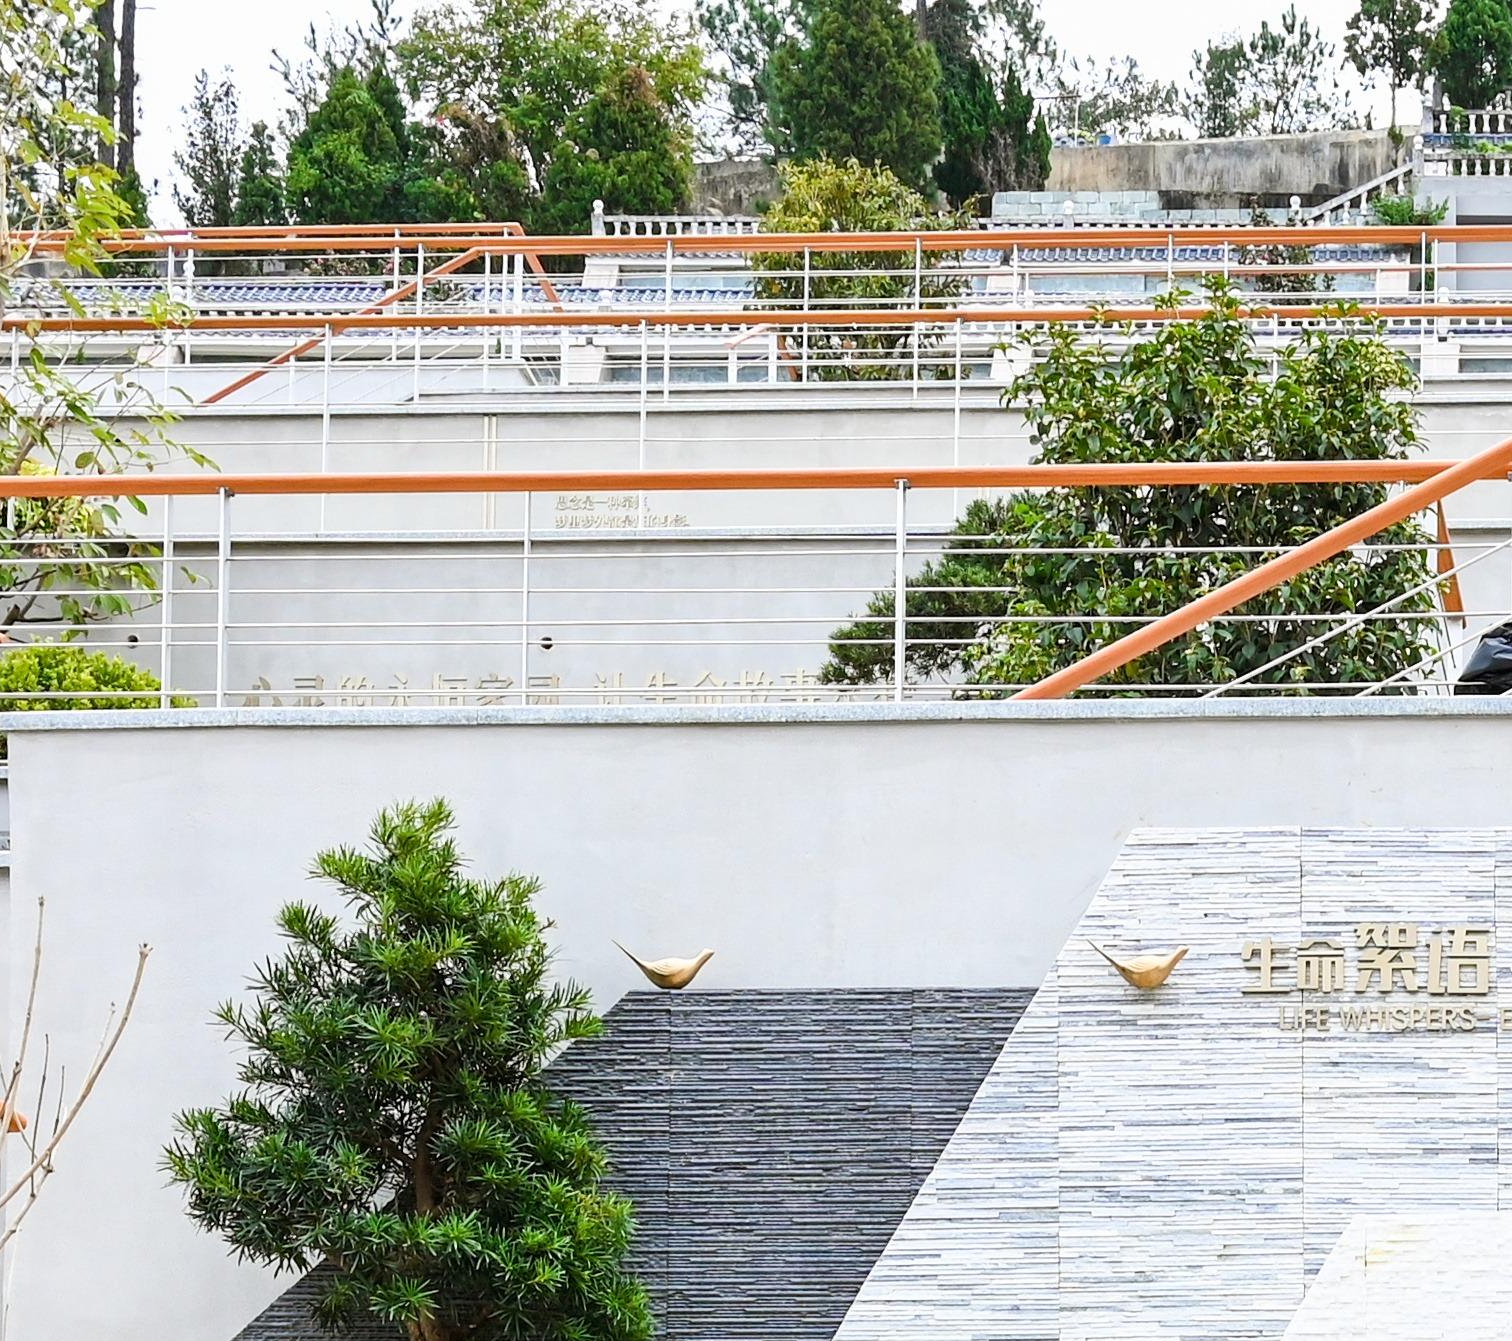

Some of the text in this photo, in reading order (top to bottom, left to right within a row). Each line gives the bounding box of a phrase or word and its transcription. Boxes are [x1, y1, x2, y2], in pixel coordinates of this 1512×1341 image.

[1241, 923, 1491, 996] 生命絮语
[1279, 1004, 1331, 1032] LIFE
